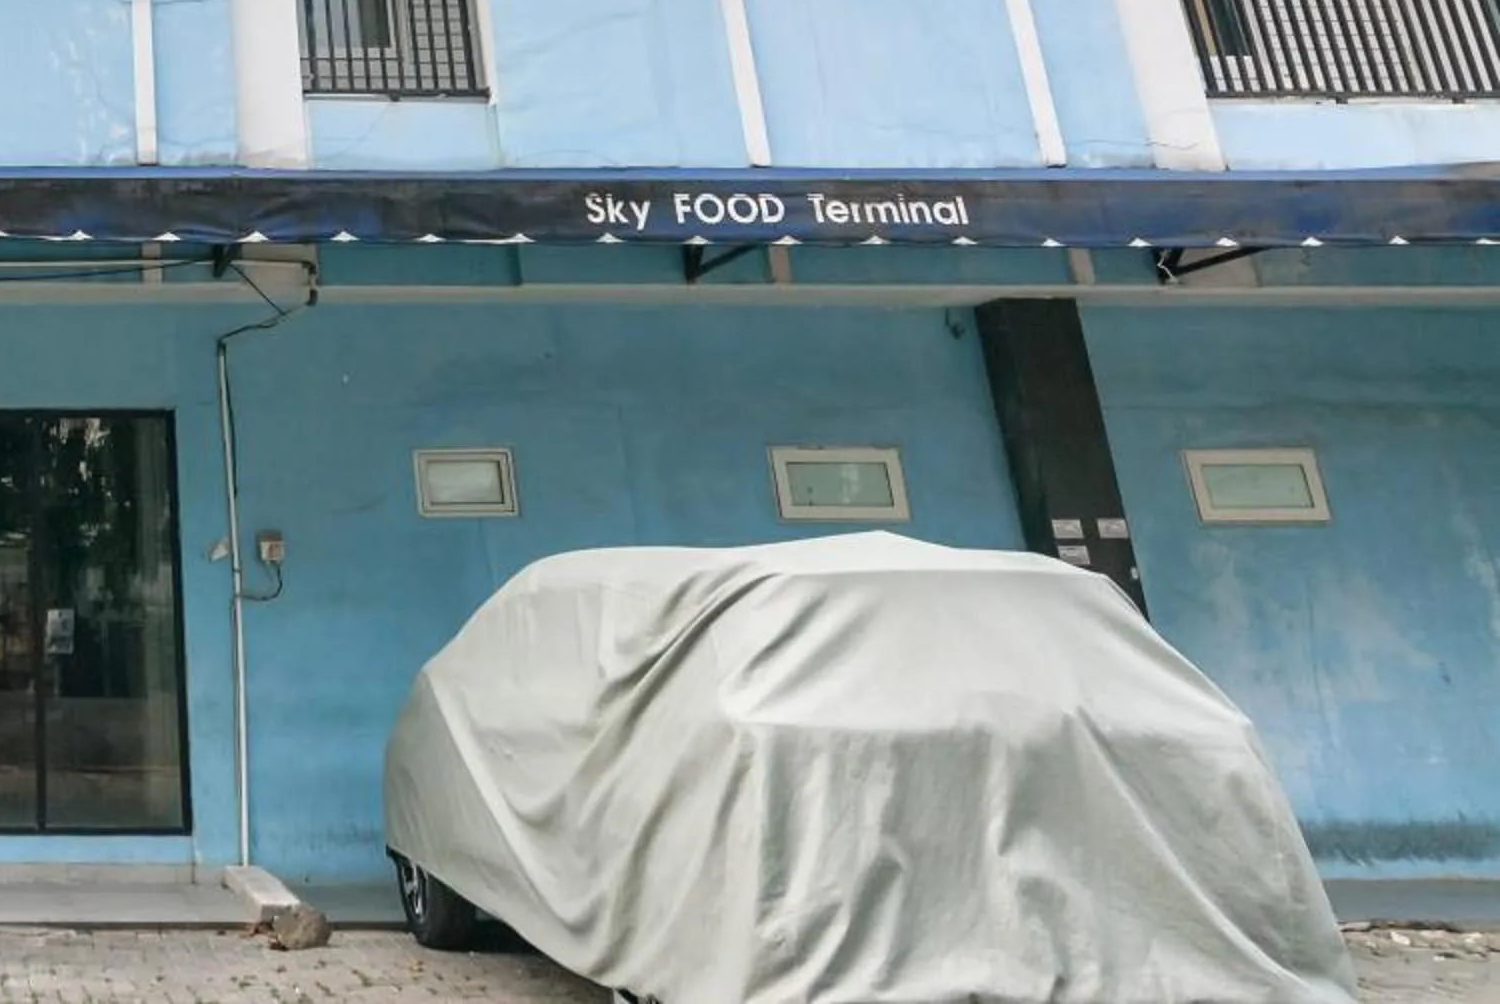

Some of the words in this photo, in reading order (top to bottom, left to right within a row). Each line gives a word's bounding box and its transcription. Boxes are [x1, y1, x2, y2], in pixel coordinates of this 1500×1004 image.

[585, 193, 651, 231] Sky
[673, 193, 785, 225] FOOD
[807, 193, 969, 225] Terminal
